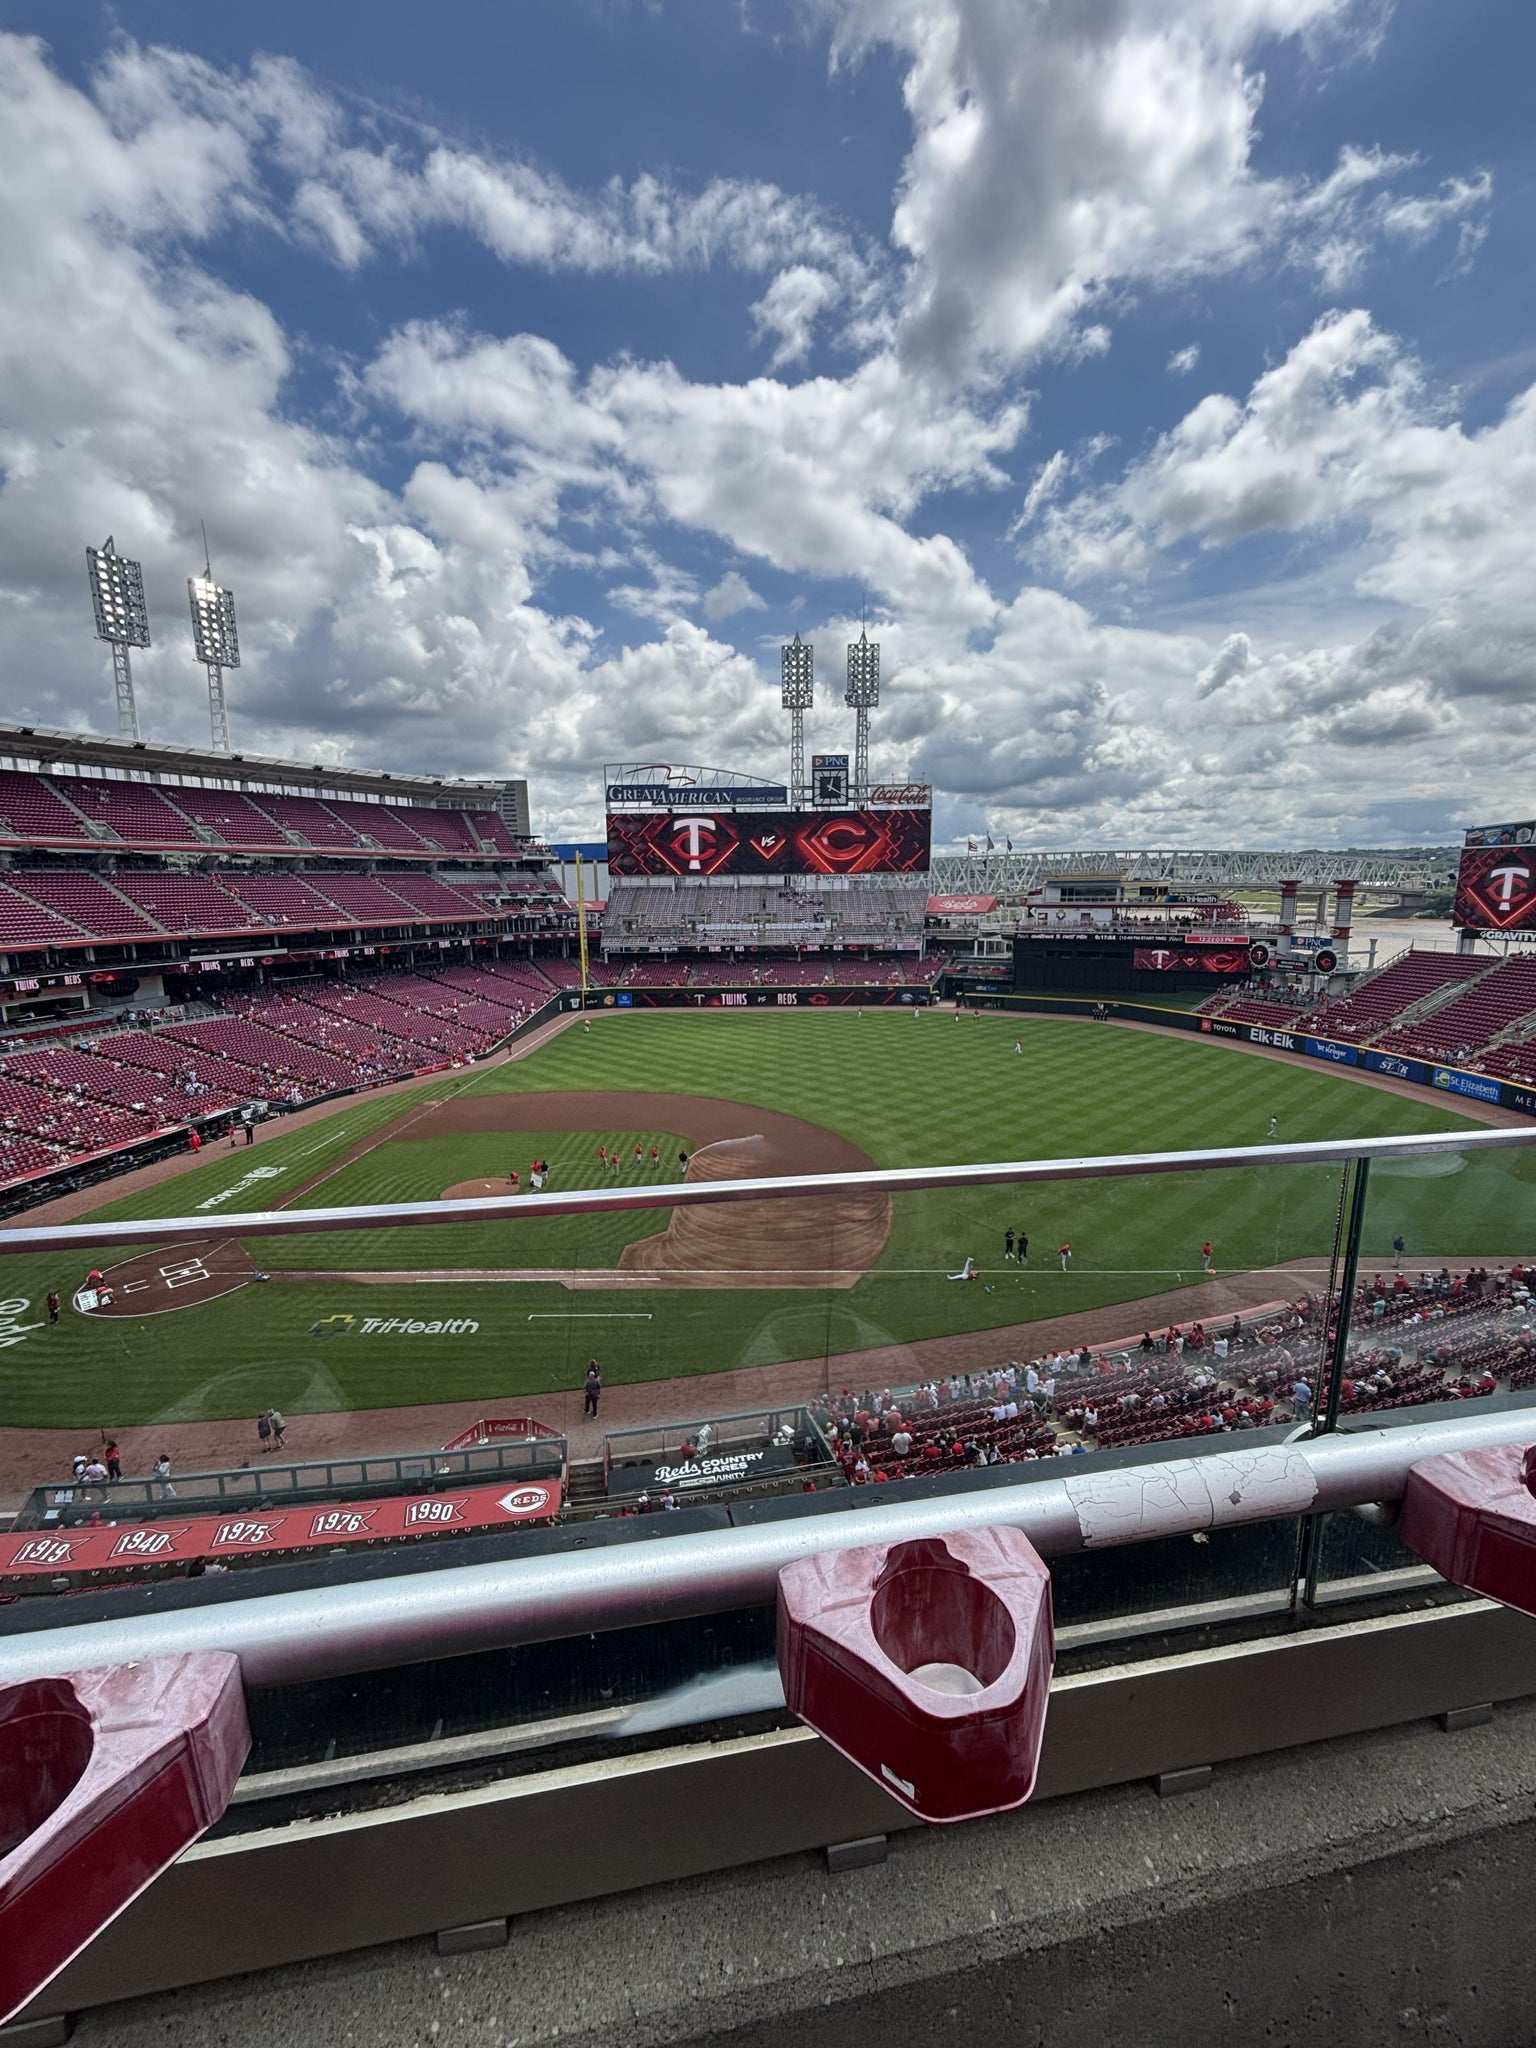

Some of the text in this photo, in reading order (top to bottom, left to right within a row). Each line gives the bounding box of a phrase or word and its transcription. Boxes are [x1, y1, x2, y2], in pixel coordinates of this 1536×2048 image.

[825, 757, 848, 766] PNC
[609, 787, 659, 801] GREAT
[656, 791, 732, 804] AMERICAN
[871, 786, 929, 805] Coca-Cola
[1305, 938, 1325, 947] PNC
[14, 979, 40, 991] TWINS
[64, 975, 82, 985] REDS
[721, 993, 748, 1005] TWINS
[777, 993, 797, 1005] REDS
[1213, 1023, 1236, 1034] TOYOTA
[1325, 1044, 1347, 1059] Kroger
[1460, 1079, 1499, 1096] Elizabeth
[360, 1318, 480, 1334] TriHealth
[702, 1452, 764, 1467] COUNTRY
[654, 1461, 702, 1483] Reds
[702, 1462, 749, 1475] CARES
[513, 1494, 547, 1505] REDS
[410, 1503, 454, 1521] 1990
[316, 1513, 363, 1532] 1976
[219, 1522, 269, 1542] 1975
[117, 1532, 170, 1553] 1940
[19, 1540, 71, 1562] 1919
